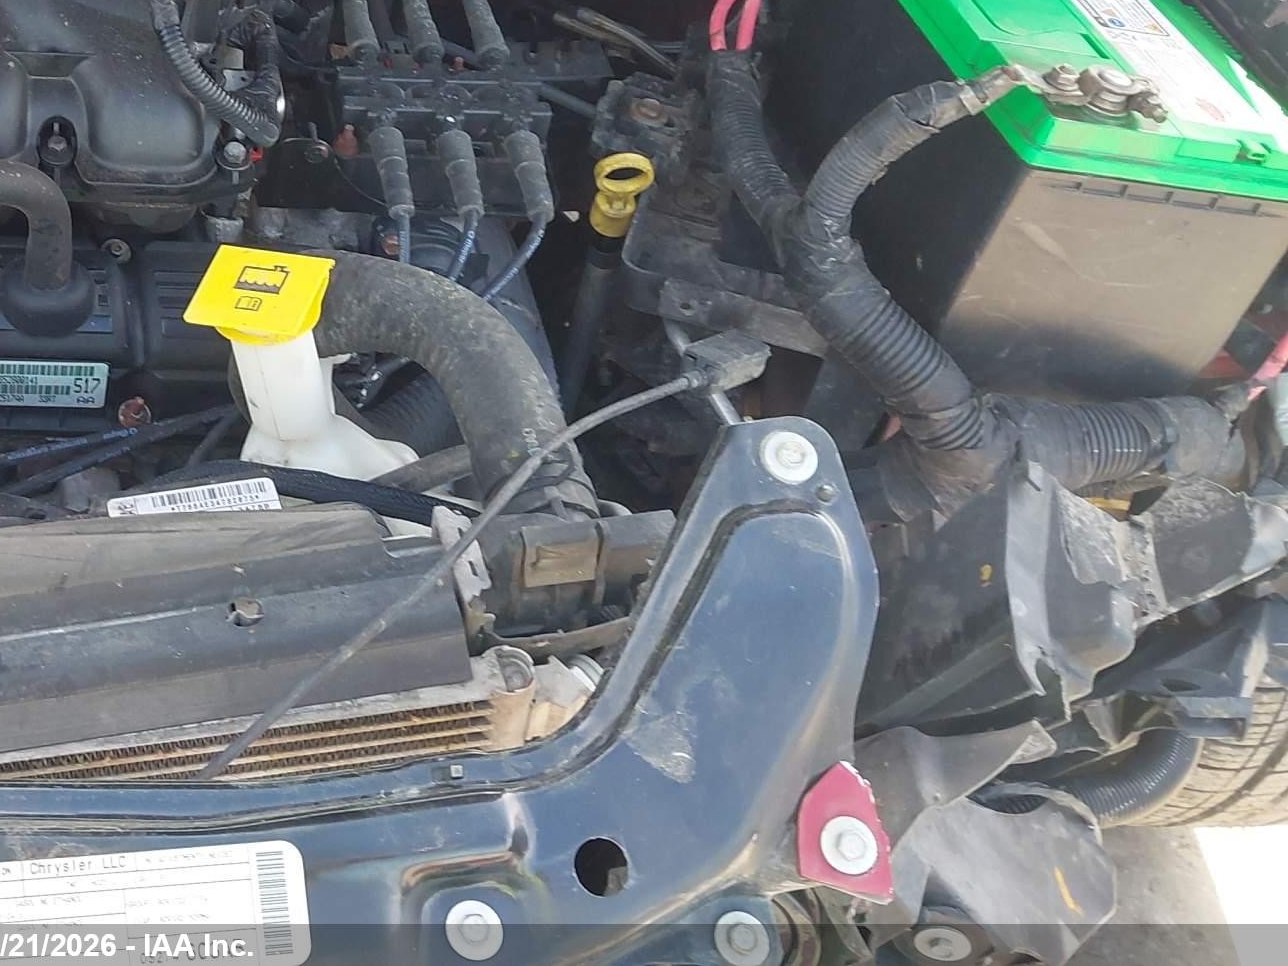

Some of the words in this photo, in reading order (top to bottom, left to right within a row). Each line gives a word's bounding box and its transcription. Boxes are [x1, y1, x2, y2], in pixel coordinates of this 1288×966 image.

[73, 377, 101, 394] 517
[29, 861, 93, 879] Chrysler
[102, 855, 127, 870] LLC
